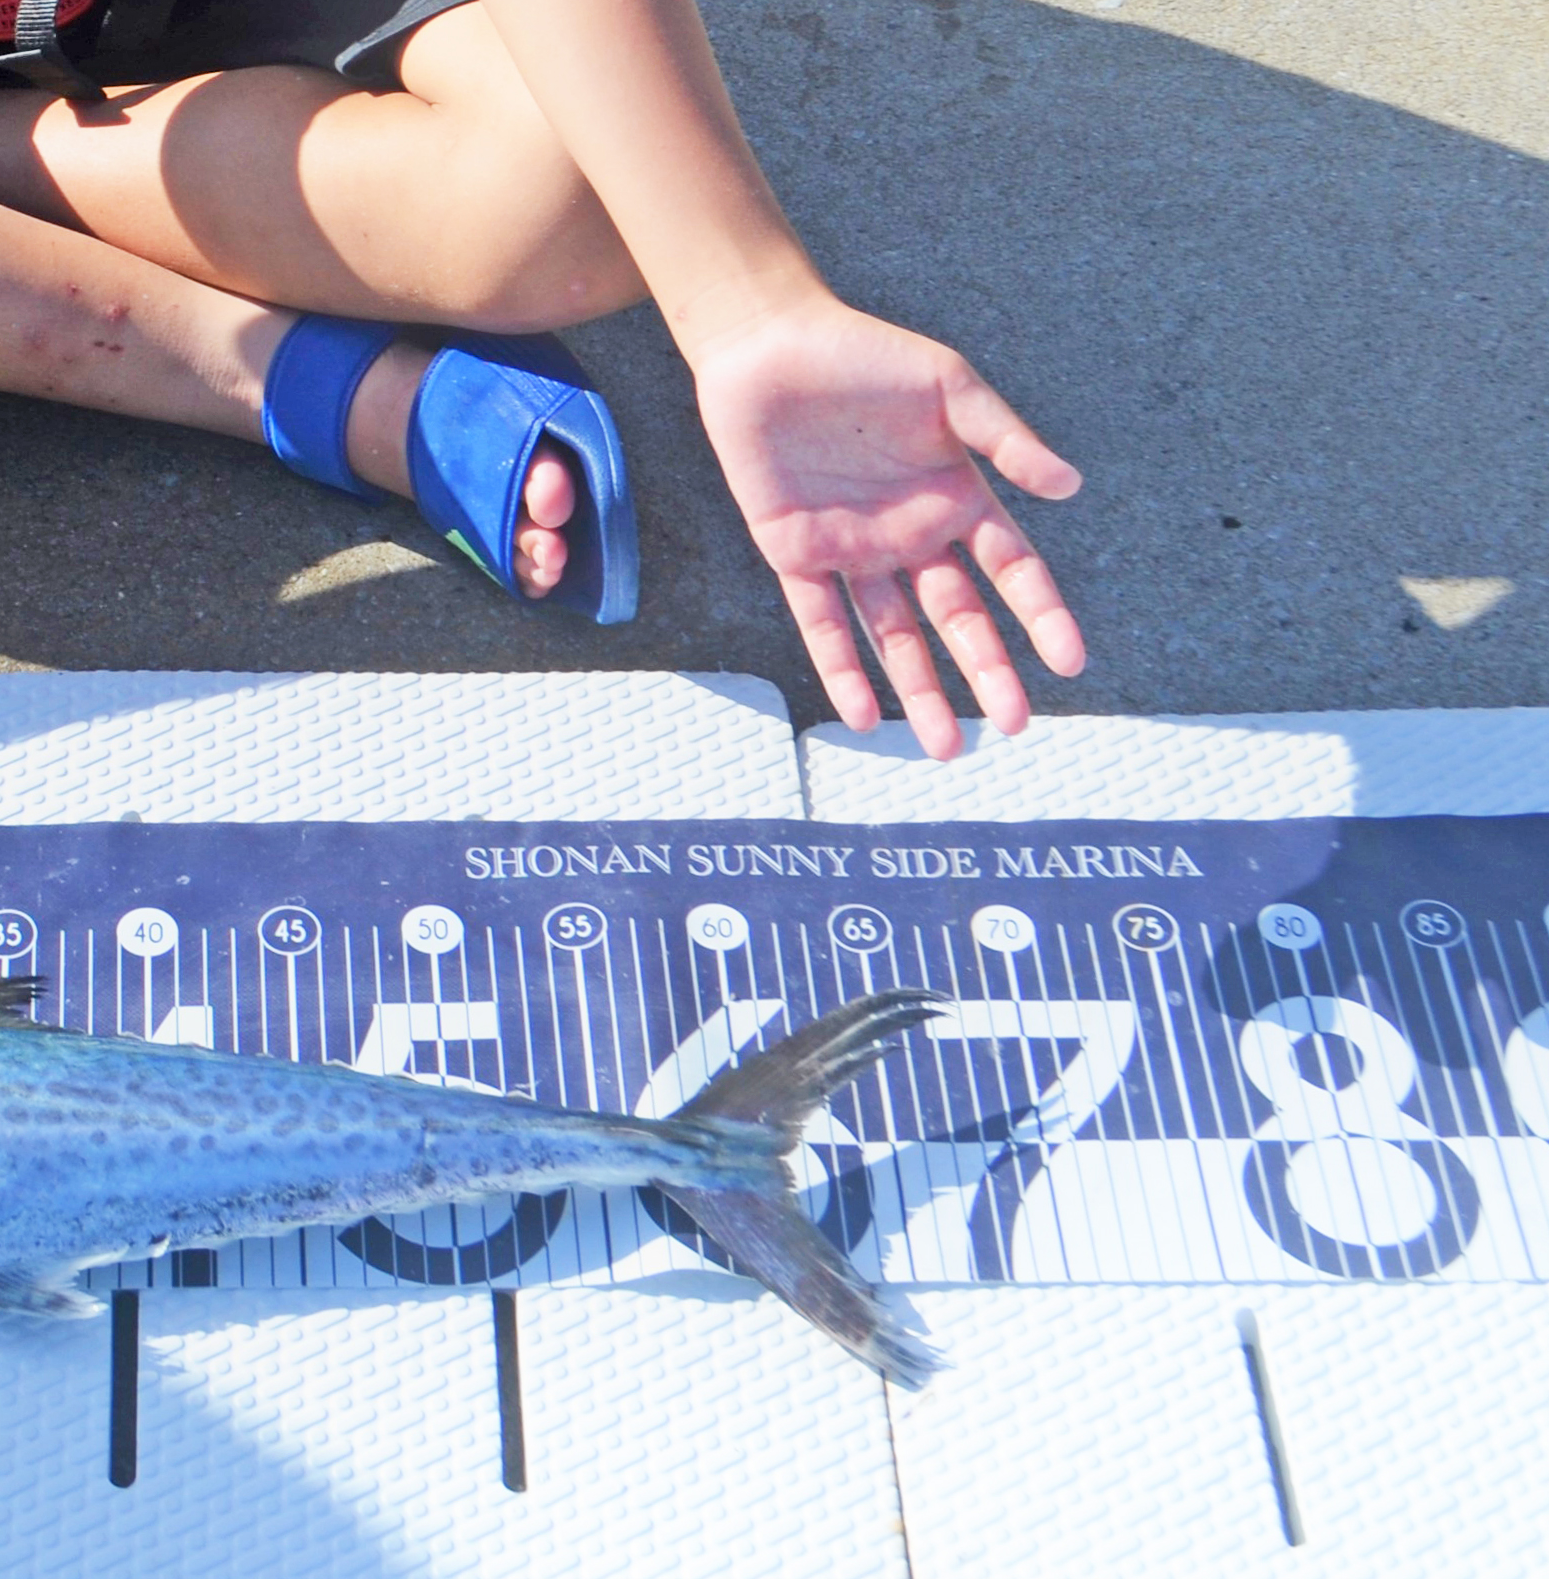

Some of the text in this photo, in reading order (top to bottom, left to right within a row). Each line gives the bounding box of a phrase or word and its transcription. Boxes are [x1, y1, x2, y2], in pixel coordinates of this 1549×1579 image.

[465, 844, 1204, 880] SHONAN SUNNY SIDE MARINA
[133, 921, 164, 944] 40
[273, 918, 308, 944] 45
[418, 918, 449, 940] 50
[558, 914, 593, 940] 55
[702, 917, 734, 938] 60
[842, 916, 878, 942] 65
[985, 918, 1020, 940] 70
[1125, 916, 1165, 941] 75
[1273, 915, 1306, 938] 80
[1415, 912, 1451, 936] 85
[926, 999, 1136, 1282] 7
[1239, 994, 1481, 1280] 8
